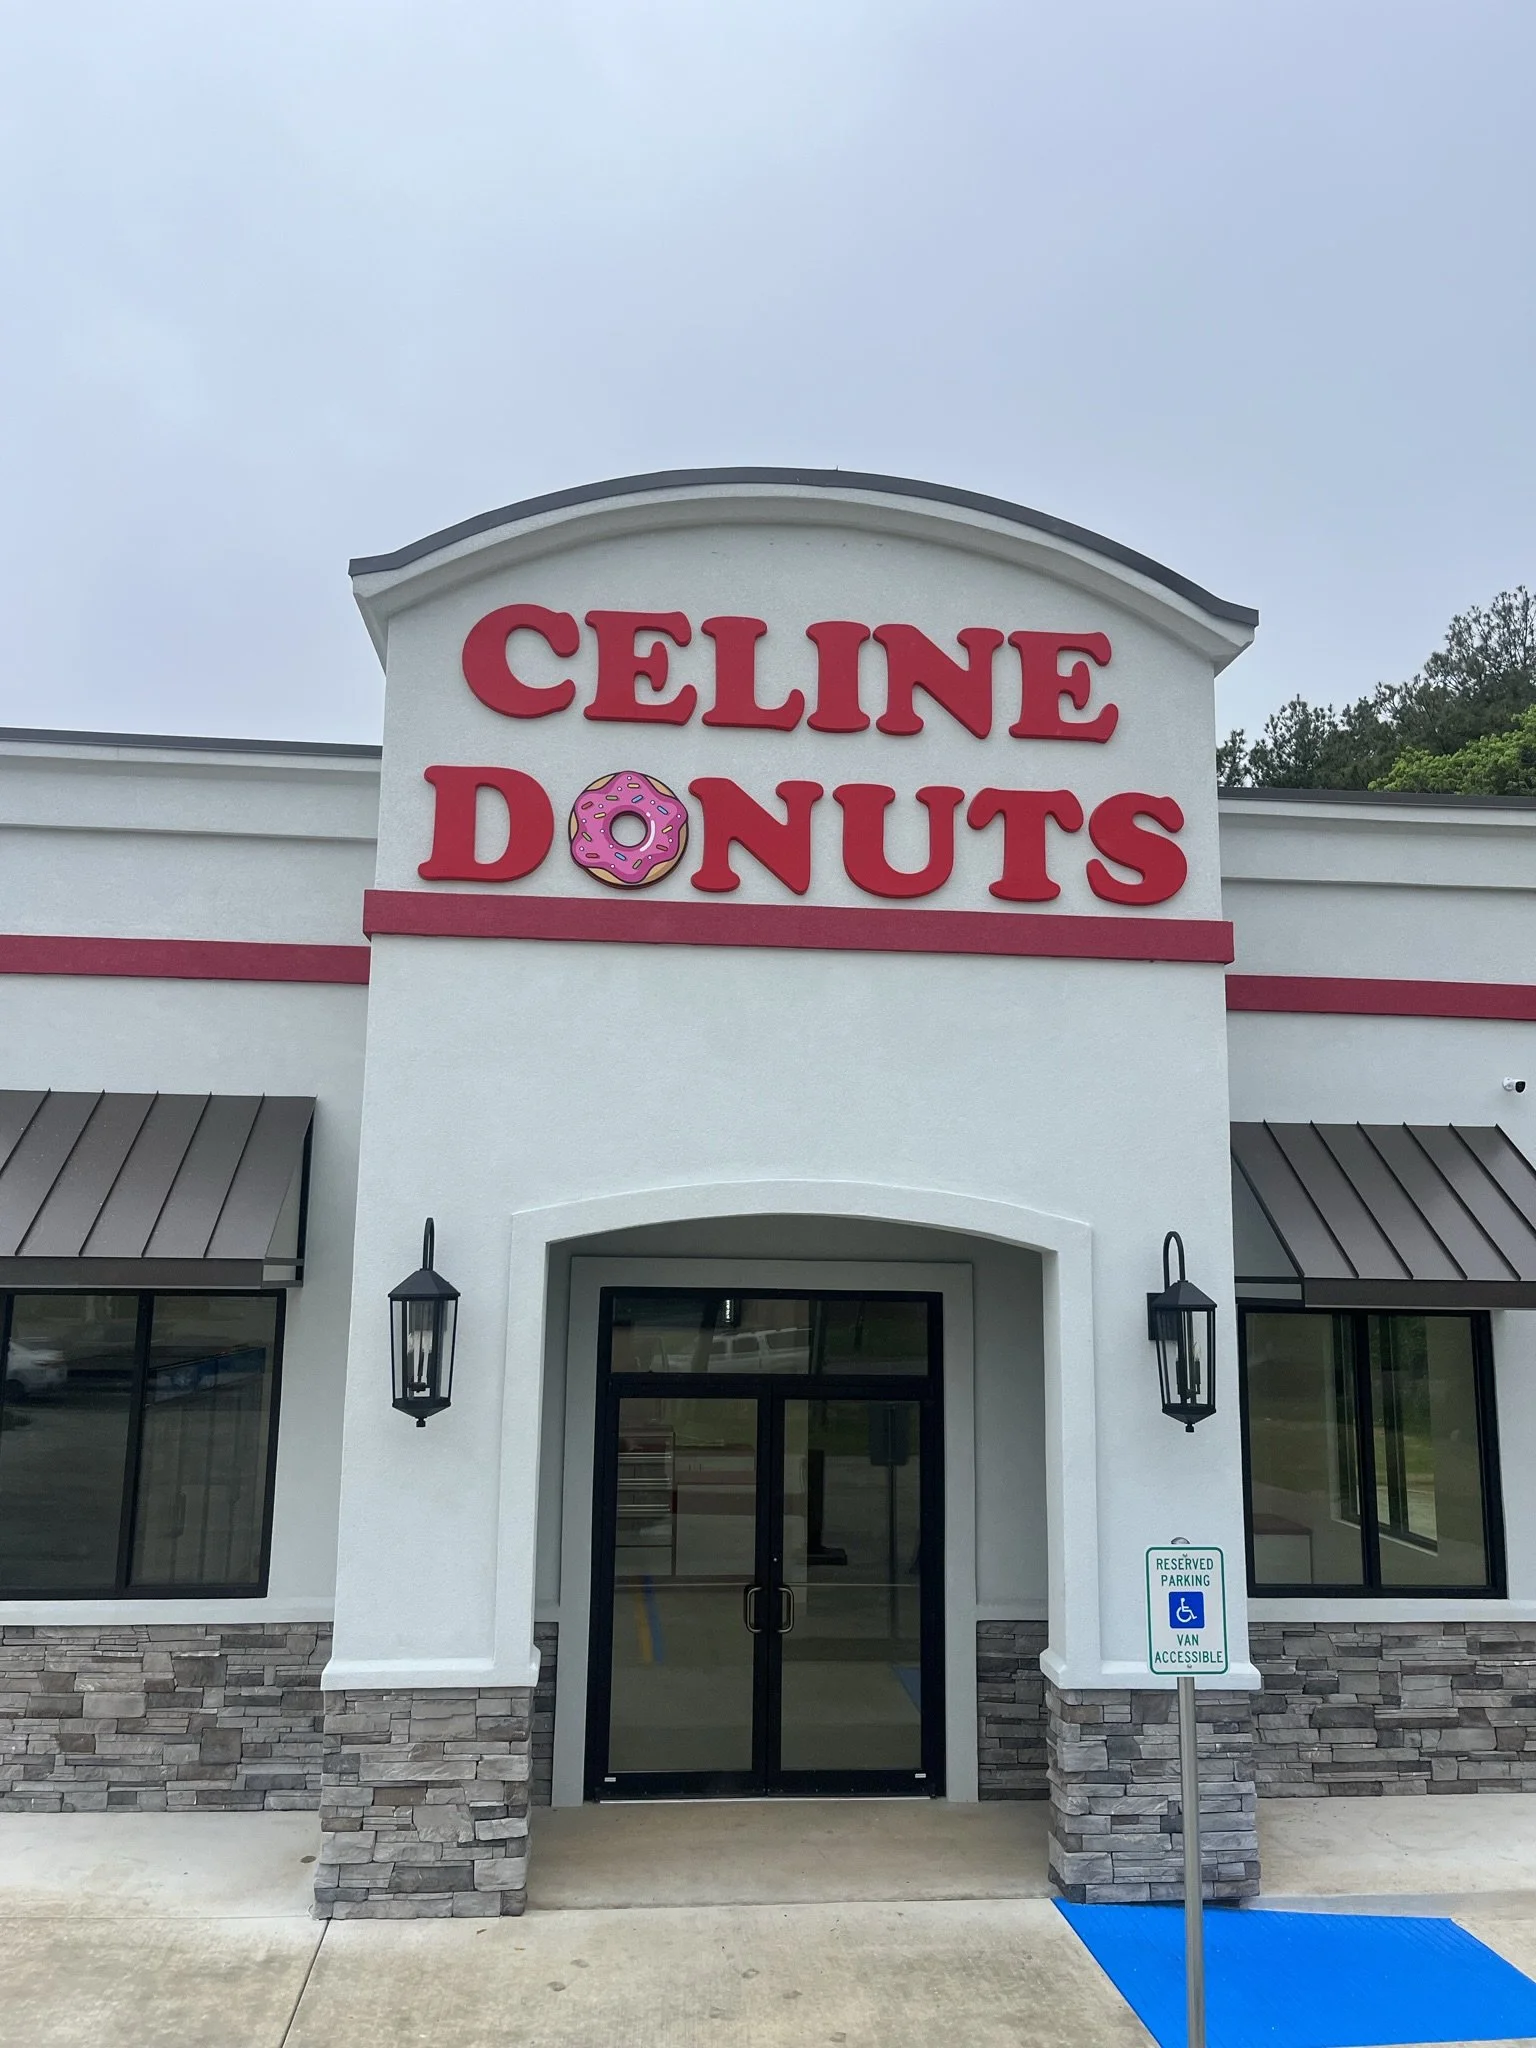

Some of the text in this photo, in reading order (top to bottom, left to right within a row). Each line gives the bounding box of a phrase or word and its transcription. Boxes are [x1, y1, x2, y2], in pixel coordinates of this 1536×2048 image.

[461, 603, 1119, 744] CELINE
[1156, 1558, 1213, 1570] RESERVED
[1161, 1574, 1210, 1586] PARKING
[1176, 1634, 1199, 1646] VAN
[1154, 1651, 1223, 1663] ACCESSIBLE
